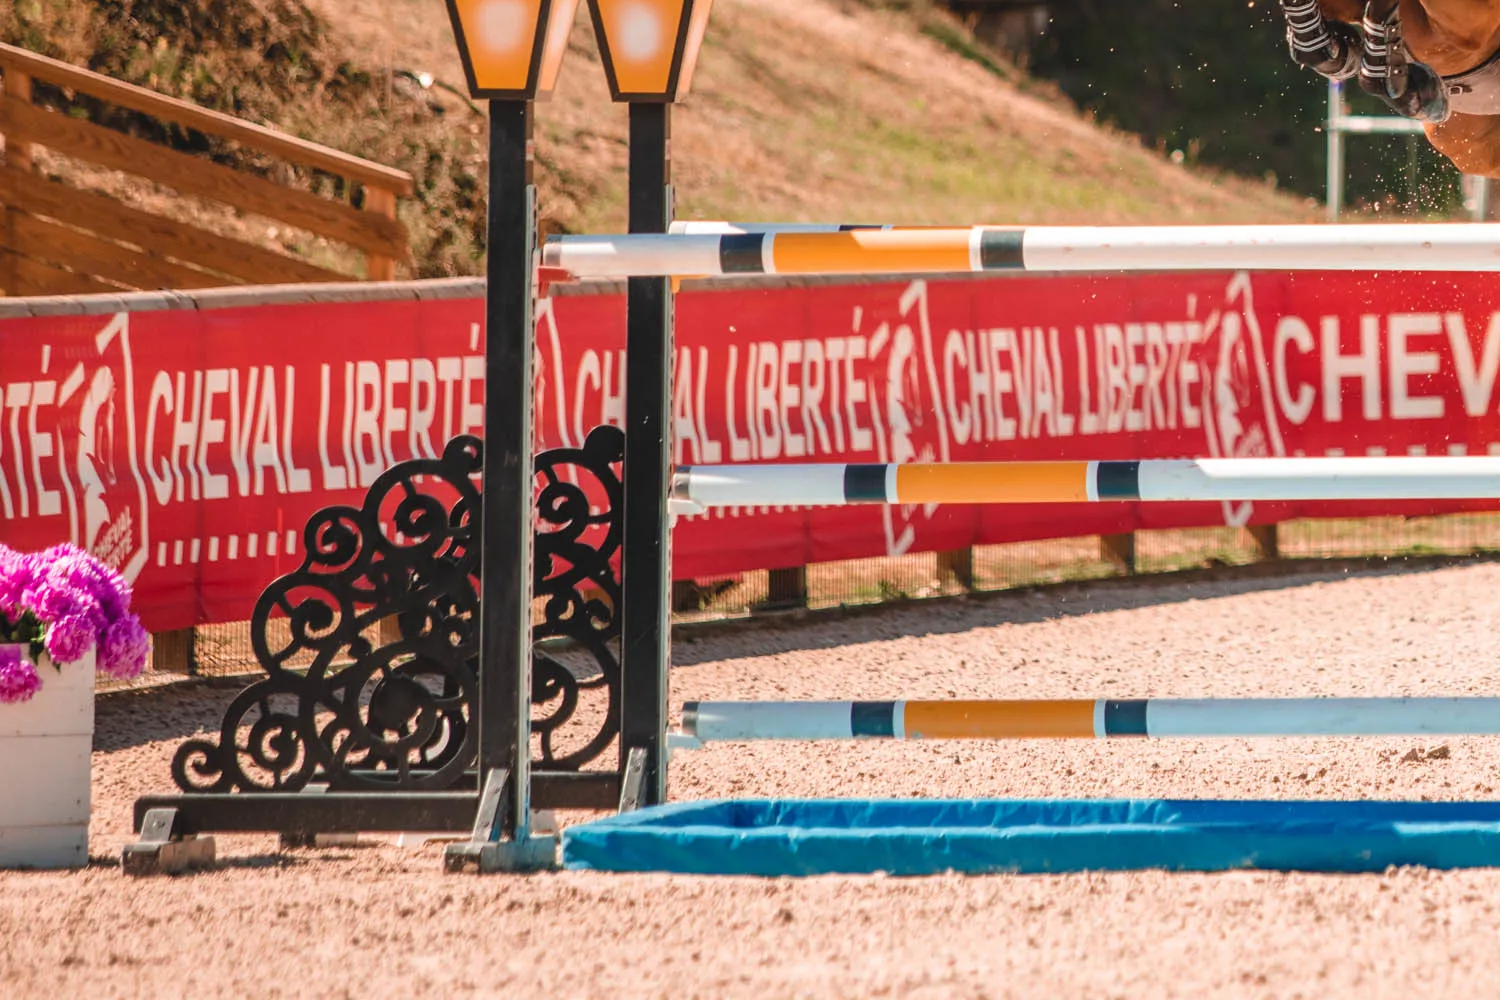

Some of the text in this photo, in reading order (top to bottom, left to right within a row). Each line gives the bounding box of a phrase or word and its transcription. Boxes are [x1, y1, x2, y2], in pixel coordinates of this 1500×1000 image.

[145, 323, 487, 505] CHEVAL LIBERTÉ
[574, 307, 874, 464] CHAL LIBERTÉ
[944, 295, 1202, 445] CHEVAL LIBERTÉ
